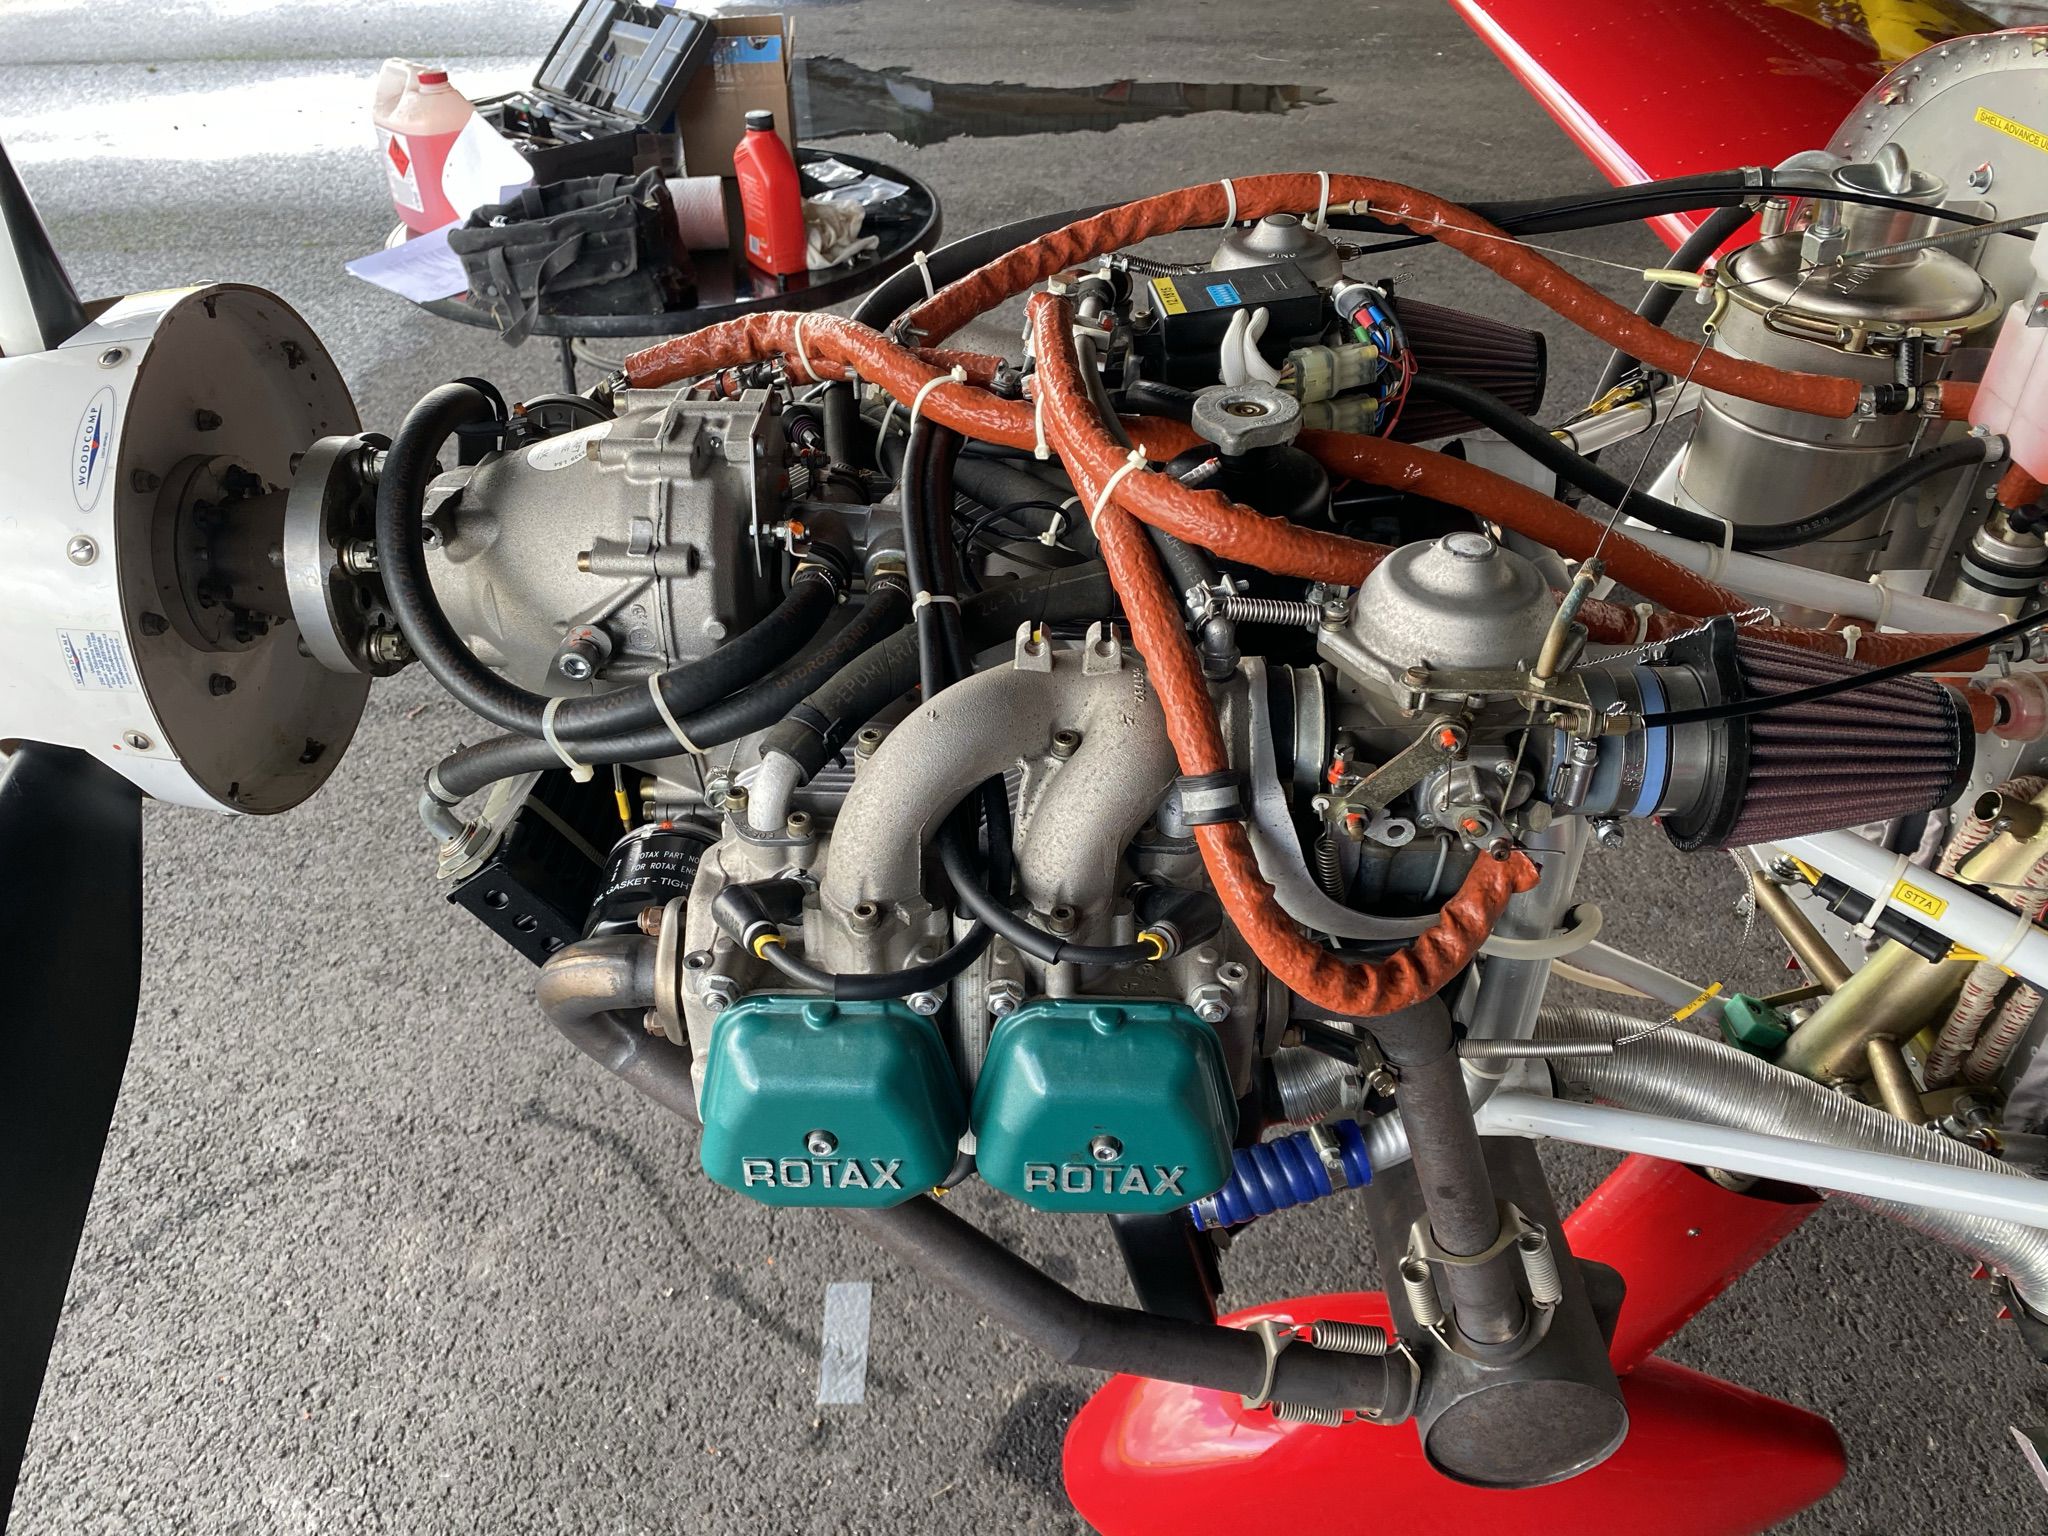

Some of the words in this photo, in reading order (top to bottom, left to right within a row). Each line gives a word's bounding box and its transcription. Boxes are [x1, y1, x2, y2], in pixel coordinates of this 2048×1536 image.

[1979, 111, 2002, 129] SHELL
[2003, 123, 2040, 145] ADVANCE
[77, 407, 98, 487] WOODCOMP
[60, 634, 82, 685] WOODCOMP
[775, 623, 870, 690] HYDROSCAND
[649, 862, 676, 872] ROTAX
[662, 850, 685, 860] PART
[605, 876, 651, 896] GASKET
[1904, 890, 1932, 910] ST7A
[742, 1157, 903, 1191] ROTAX
[1023, 1163, 1187, 1197] ROTAX
